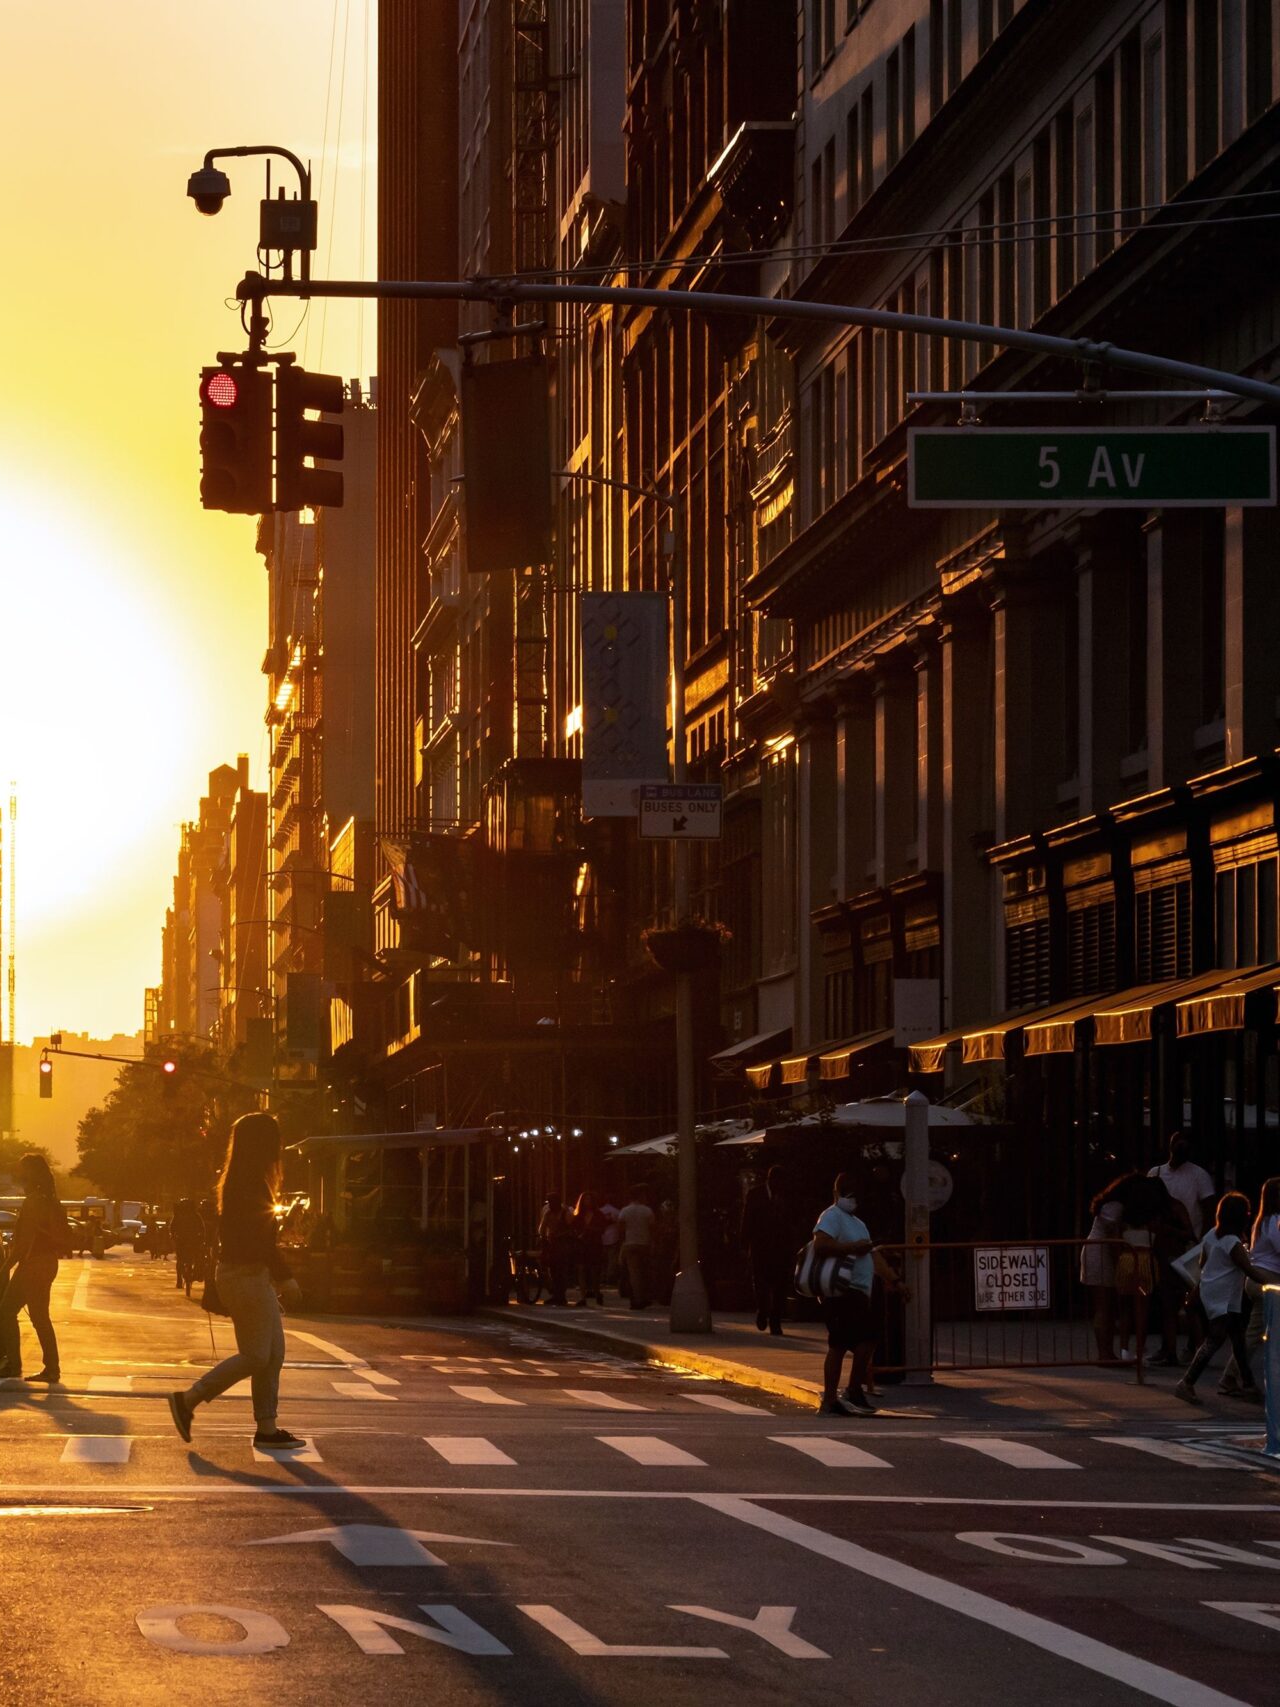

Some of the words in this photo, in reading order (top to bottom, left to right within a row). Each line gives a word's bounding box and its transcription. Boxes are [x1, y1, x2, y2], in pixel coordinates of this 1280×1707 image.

[1038, 446, 1061, 489] 5
[1087, 445, 1146, 488] Av
[662, 788, 684, 797] BUS
[688, 788, 717, 798] LANE
[644, 801, 682, 813] BUSES
[688, 801, 718, 813] ONLY
[978, 1254, 1046, 1270] SIDEWALK
[986, 1272, 1038, 1288] CLOSED
[979, 1291, 995, 1303] USE
[998, 1291, 1025, 1302] OTHER
[1028, 1290, 1046, 1301] SIDE
[136, 1604, 832, 1659] ONLY
